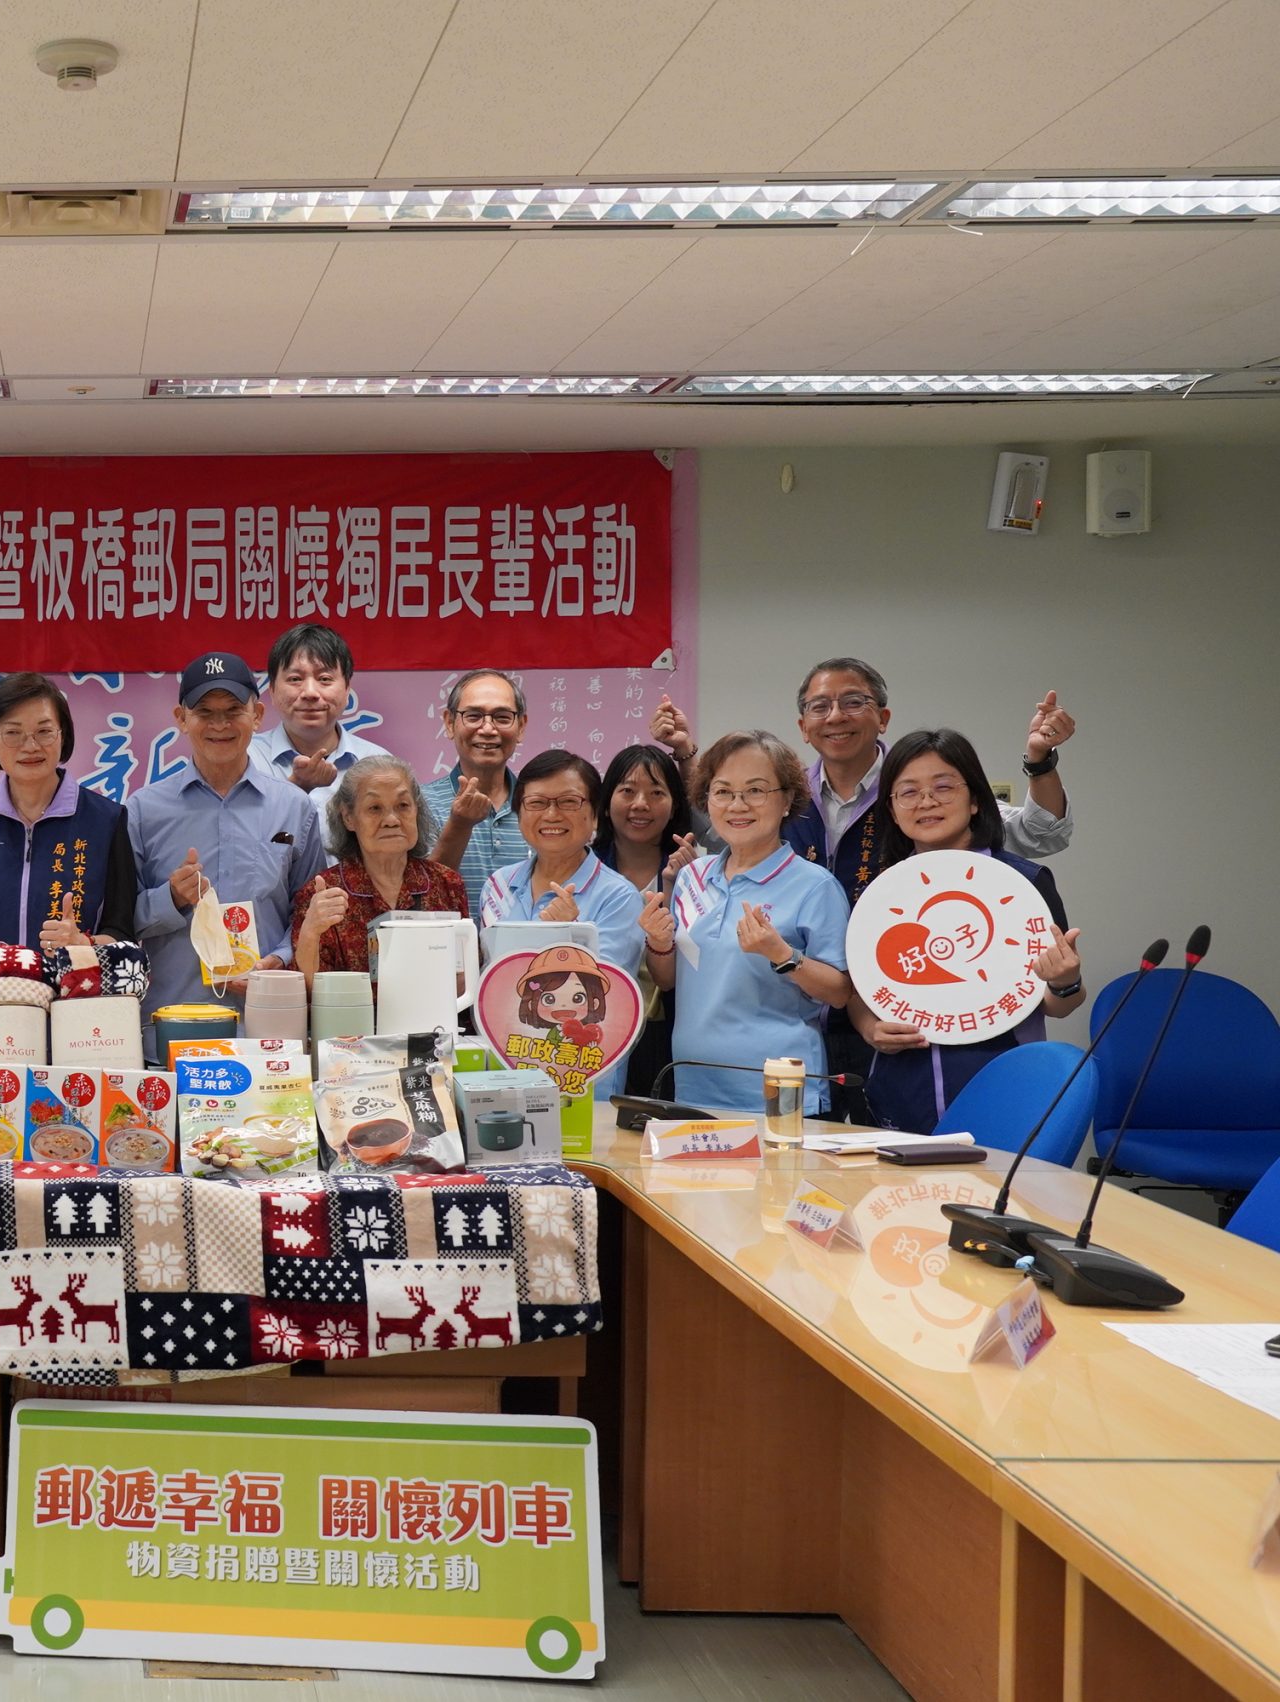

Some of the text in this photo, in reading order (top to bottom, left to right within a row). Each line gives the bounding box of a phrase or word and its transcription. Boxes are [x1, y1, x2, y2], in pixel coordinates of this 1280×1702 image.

[51, 842, 66, 872] 局長
[897, 924, 979, 978] 好 子
[70, 1038, 125, 1048] MONTAGUT
[505, 1033, 605, 1071] 郵政壽險
[185, 1067, 229, 1079] 活力多
[190, 1078, 232, 1090] 堅果飲
[405, 1075, 431, 1089] 紫米
[35, 1466, 575, 1545] 郵遞幸福 關懷列車
[126, 1541, 481, 1592] 物資捐贈暨關懷活動
